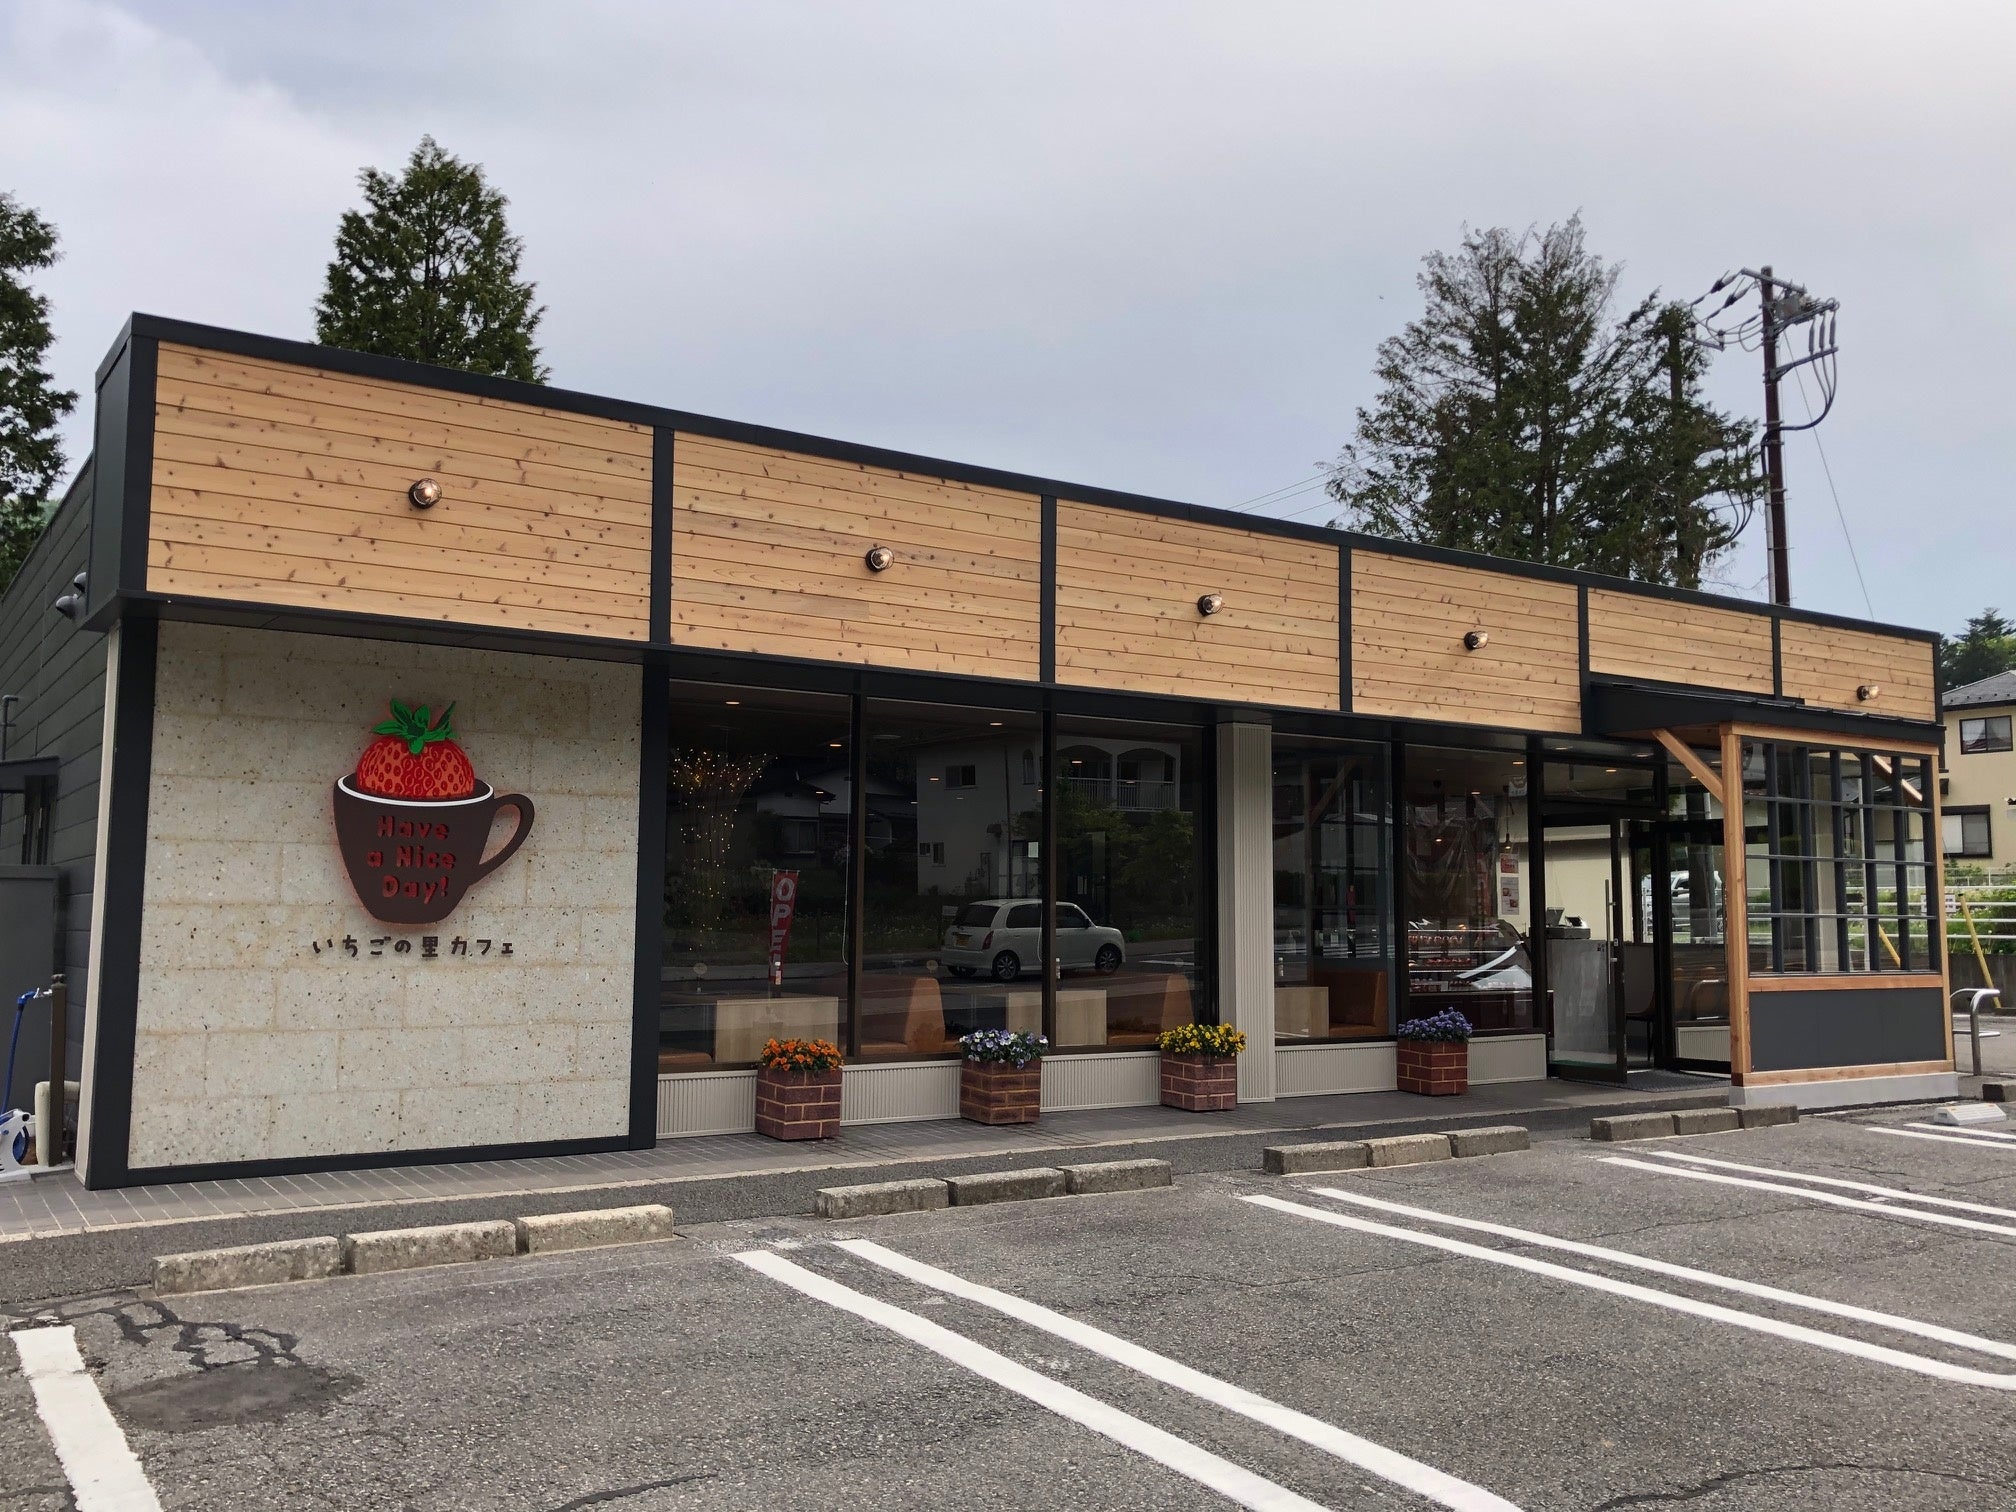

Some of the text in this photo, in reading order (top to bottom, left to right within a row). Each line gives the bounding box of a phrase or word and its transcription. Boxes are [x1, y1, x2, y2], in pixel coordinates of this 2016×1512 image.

[377, 815, 449, 839] Have
[366, 846, 456, 868] a Nice
[382, 875, 448, 904] Day!
[312, 934, 514, 958] いちごの里カフェ
